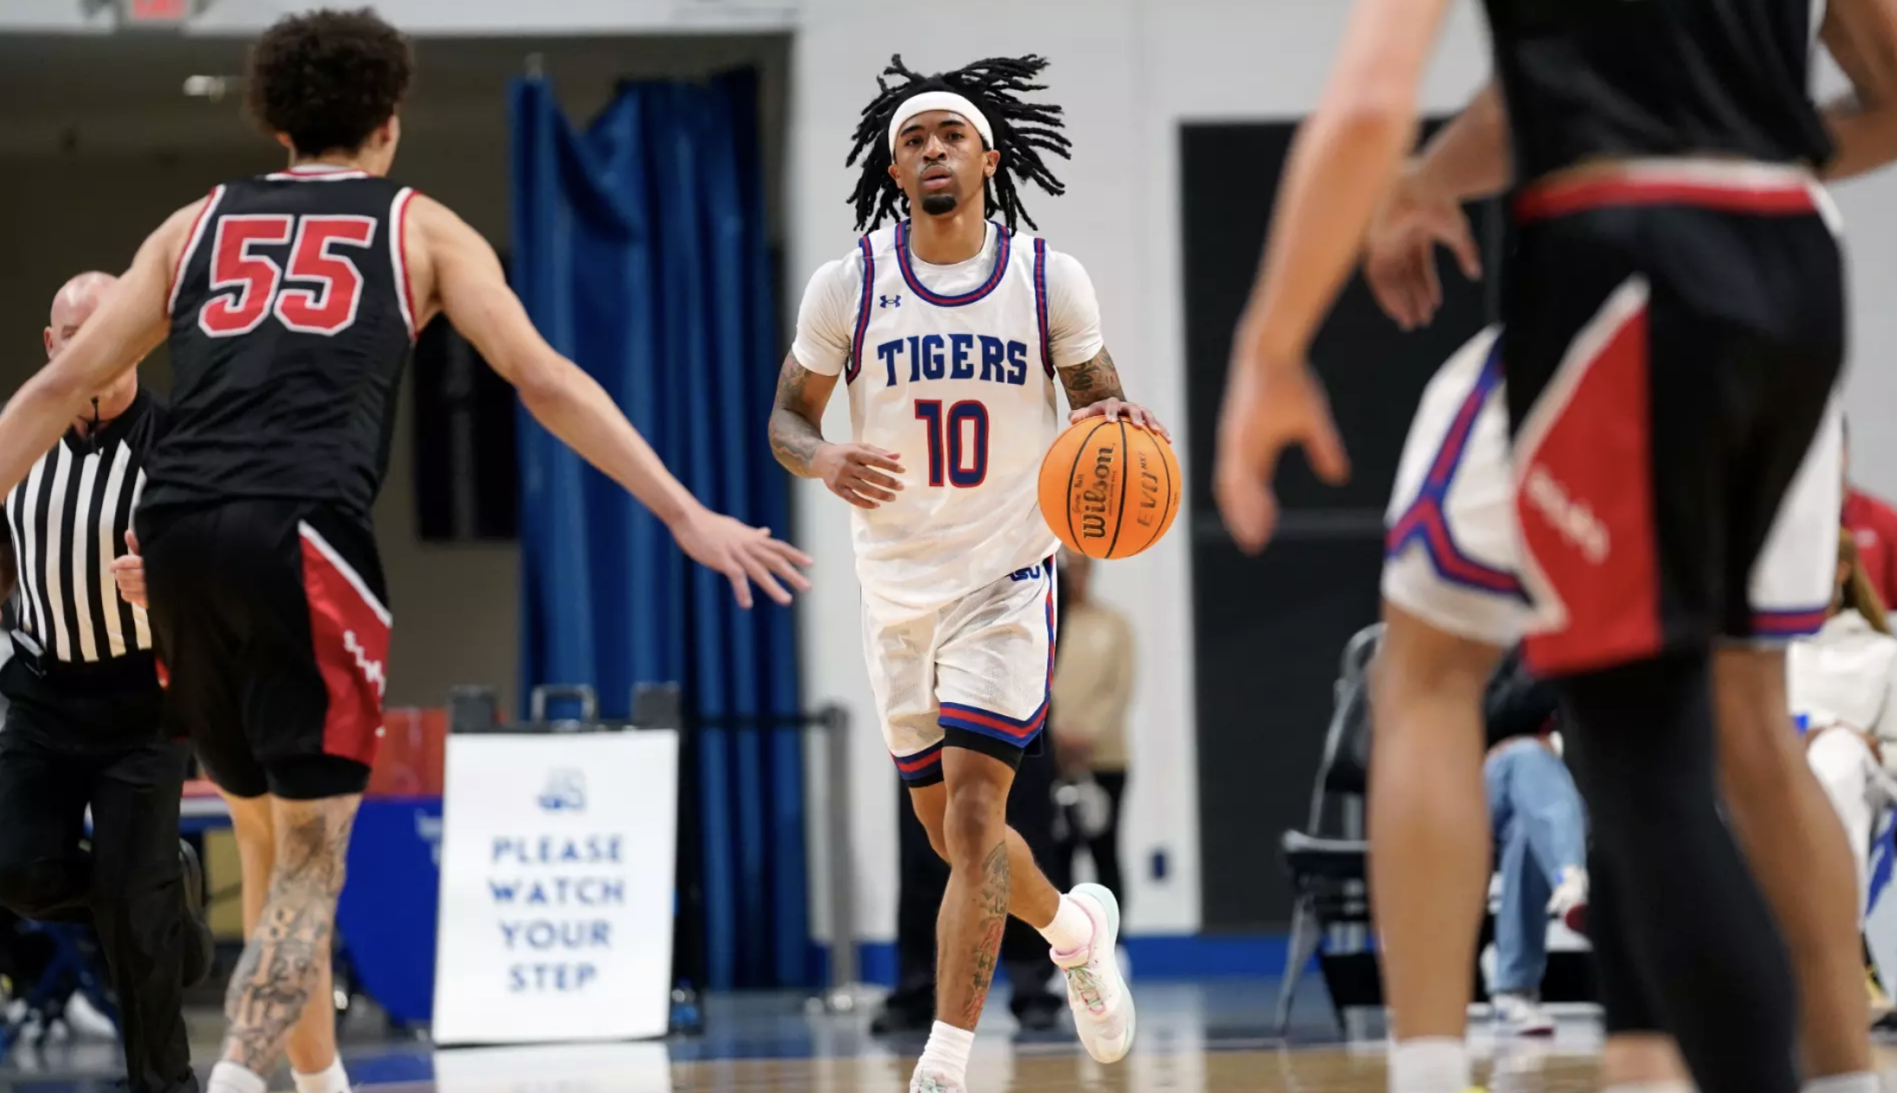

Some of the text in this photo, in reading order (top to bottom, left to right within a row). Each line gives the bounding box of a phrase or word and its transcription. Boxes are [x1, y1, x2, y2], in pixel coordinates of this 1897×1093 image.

[198, 214, 377, 338] 55
[877, 333, 1028, 387] TIGERS
[914, 398, 989, 488] 10
[1083, 447, 1114, 538] Wilson
[1137, 471, 1158, 527] EVO
[492, 836, 623, 863] PLEASE
[488, 878, 625, 905] WATCH
[499, 920, 611, 949] YOUR
[509, 963, 596, 992] STEP
